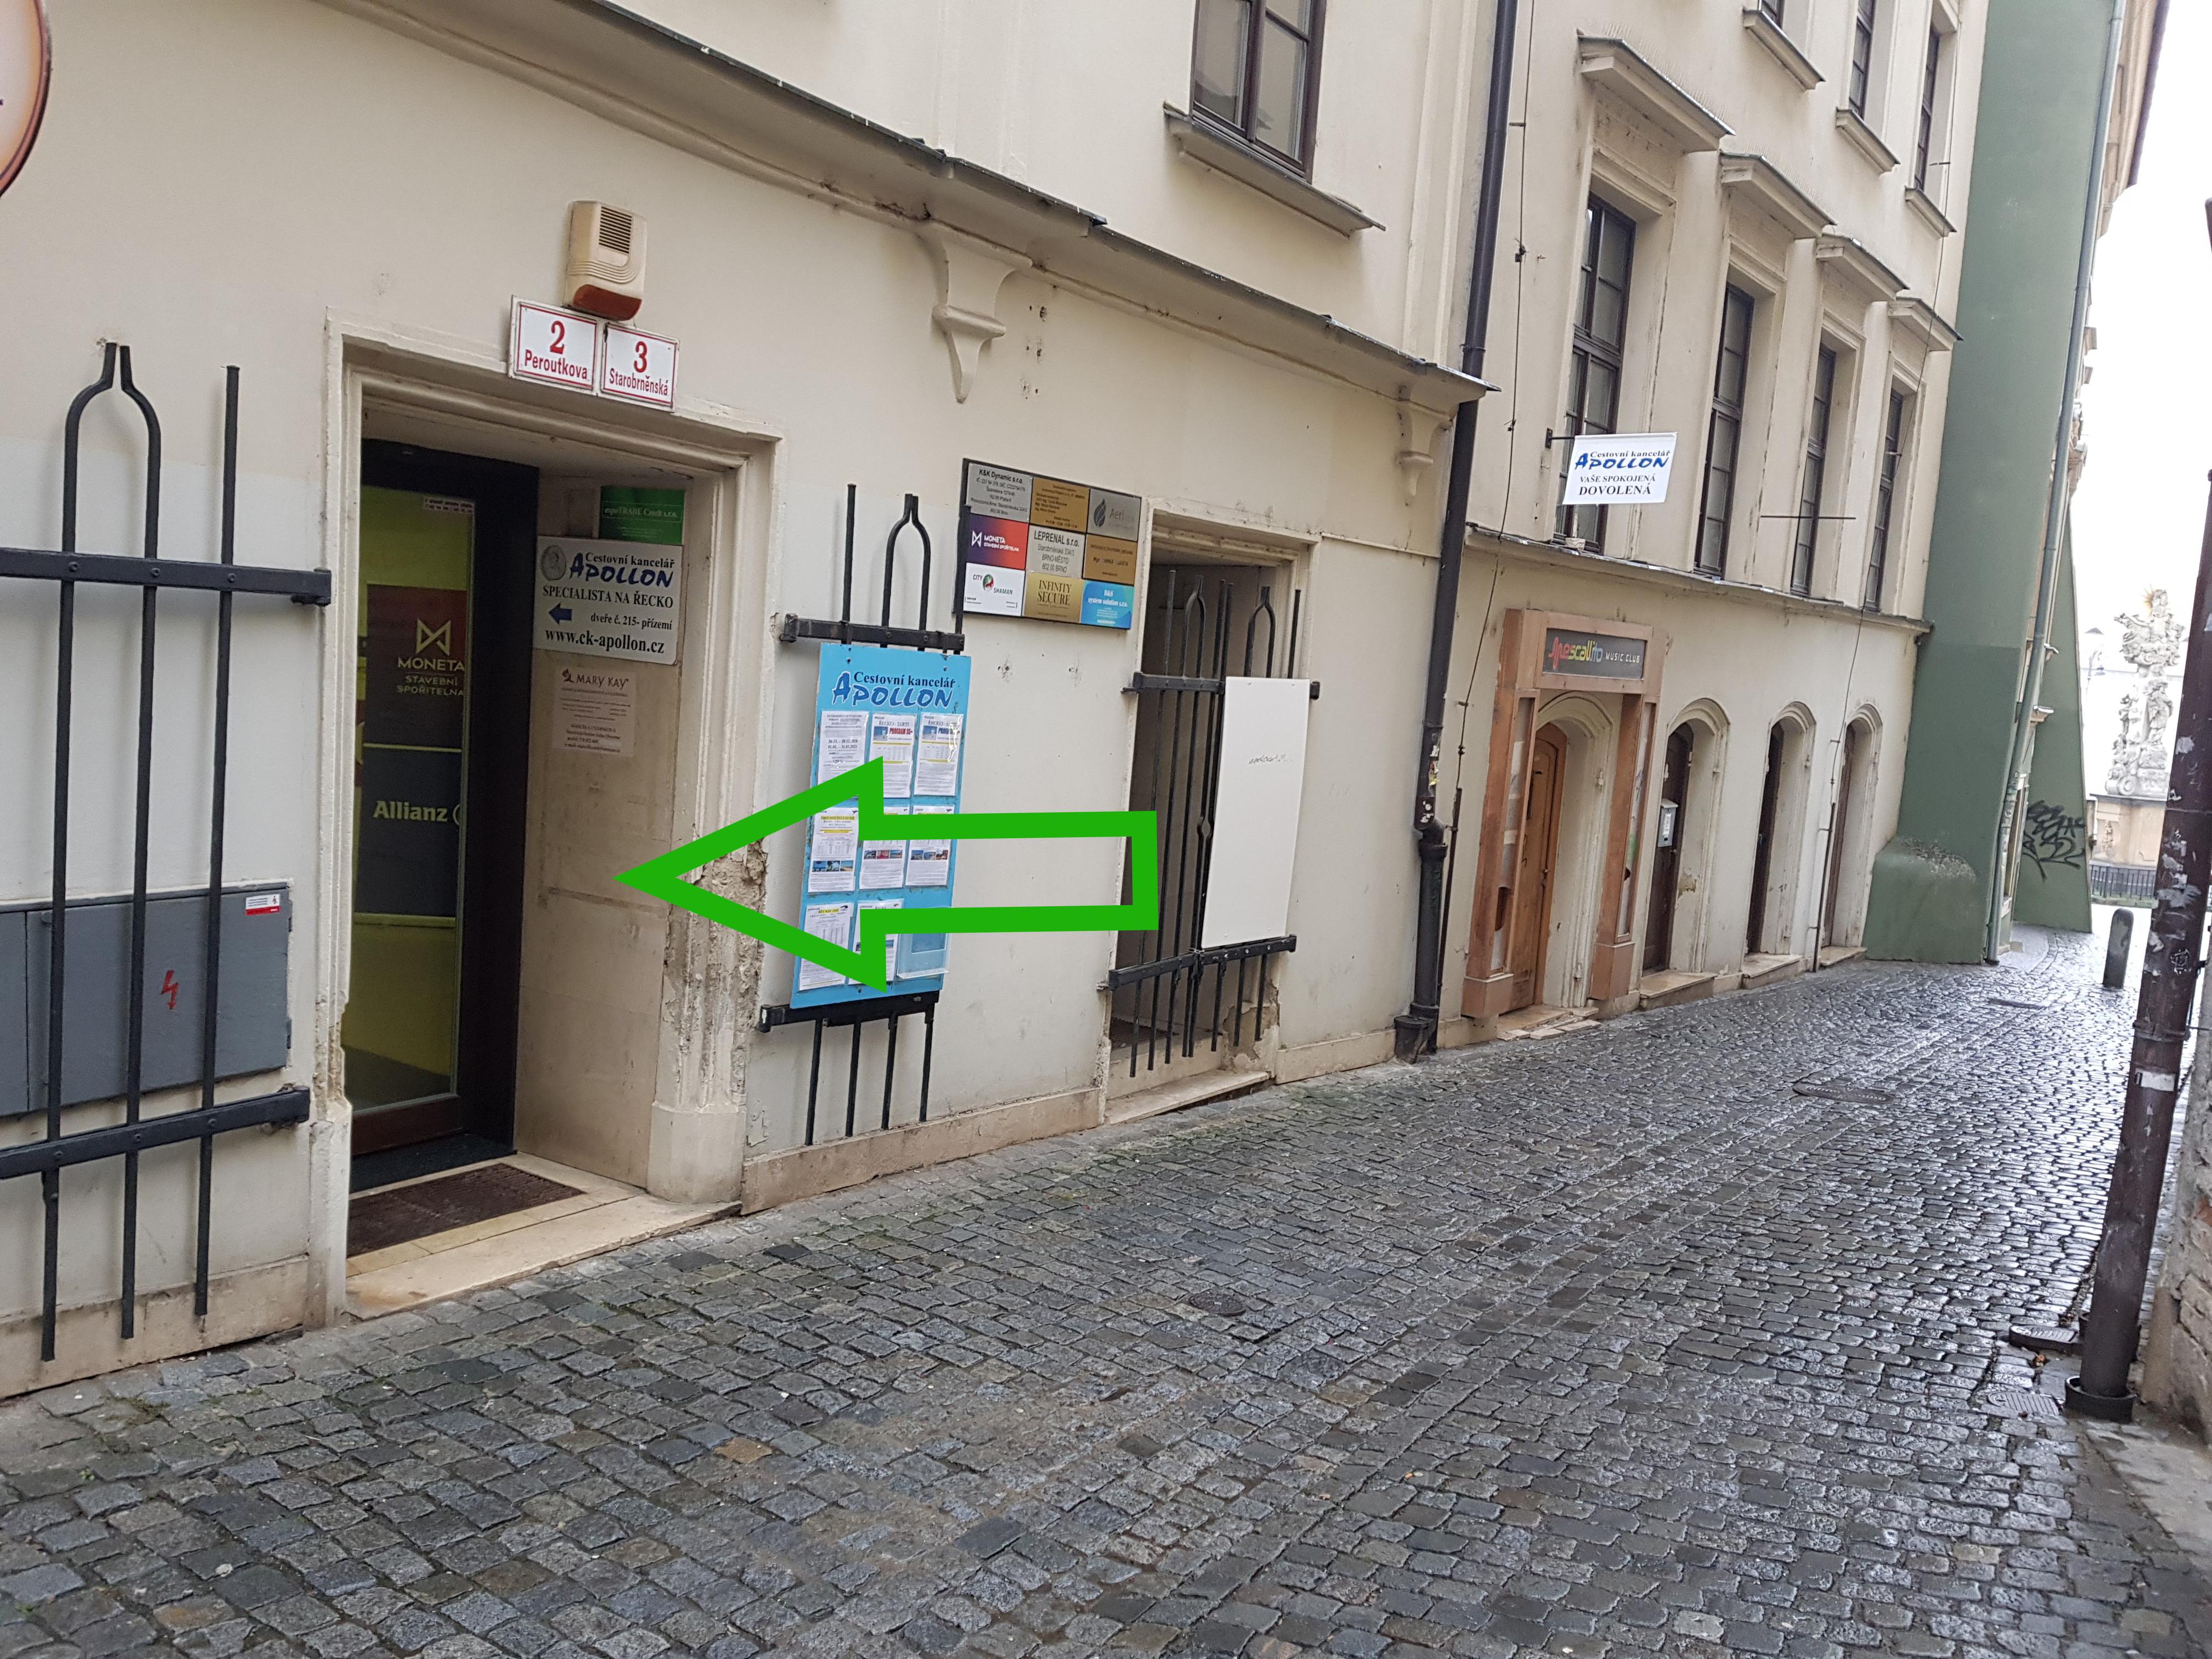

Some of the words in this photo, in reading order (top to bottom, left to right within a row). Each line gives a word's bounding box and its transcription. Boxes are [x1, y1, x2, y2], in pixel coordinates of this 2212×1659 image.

[550, 321, 565, 354] 2
[525, 349, 587, 379] Peroutkova
[634, 341, 648, 373] 3
[609, 368, 668, 396] Starobrněnská
[1575, 452, 1669, 469] APOLLON
[991, 471, 1011, 481] Dynamic
[1580, 474, 1600, 483] VAŠE
[1602, 473, 1656, 482] SPOKOJENÁ
[1579, 483, 1651, 495] DOVOLENÁ
[984, 535, 1005, 544] MONETA
[1034, 530, 1065, 545] LEPRENAL
[1066, 539, 1079, 547] s.r.o.
[586, 552, 628, 564] Cestovní
[631, 555, 675, 568] kancelář
[569, 552, 674, 588] APOLLON
[1039, 580, 1072, 593] INFINITY
[542, 585, 611, 602] SPECIALISTA
[615, 592, 629, 604] NA
[634, 591, 673, 608] ŘECKO
[1037, 591, 1070, 606] SECURE
[591, 613, 612, 623] dveře
[641, 618, 672, 630] přízemí
[545, 629, 665, 654] www.ck-apollon.cz
[398, 657, 465, 671] MONETA
[1605, 652, 1623, 662] MUSIC
[1626, 653, 1640, 663] CLUB
[405, 675, 458, 686] STAVEBNÍ
[577, 674, 604, 688] MARY
[854, 671, 905, 686] Cestovní
[908, 675, 956, 688] kancelář
[397, 685, 464, 696] SPOŘITELNA
[832, 671, 953, 708] APOLLON
[373, 801, 447, 822] Allianz
